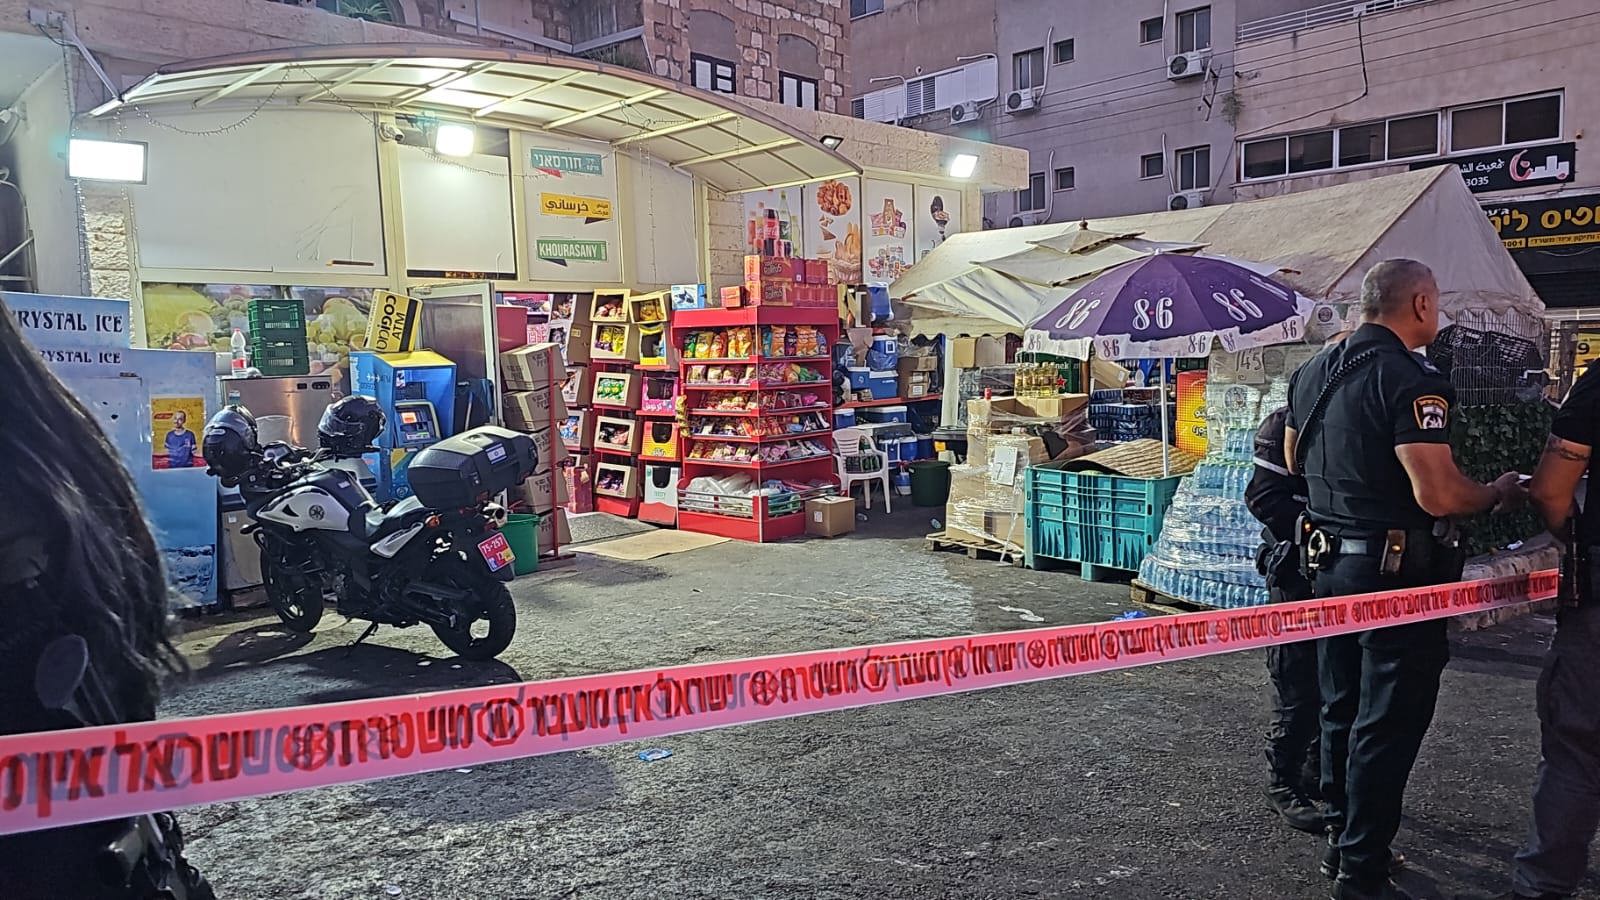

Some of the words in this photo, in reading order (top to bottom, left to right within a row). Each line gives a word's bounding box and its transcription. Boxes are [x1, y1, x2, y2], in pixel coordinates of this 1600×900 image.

[534, 154, 581, 169] חורסאני
[539, 242, 597, 258] KHOURASANY
[12, 310, 87, 331] RYSTAL
[95, 314, 123, 333] ICE
[392, 312, 406, 340] ATM
[99, 352, 121, 364] ICE
[526, 687, 610, 737] מעבר
[614, 683, 654, 734] אין
[656, 672, 735, 718] ישראל
[338, 704, 473, 768] משטרת
[37, 746, 105, 818] אין
[114, 730, 256, 793] ישראל
